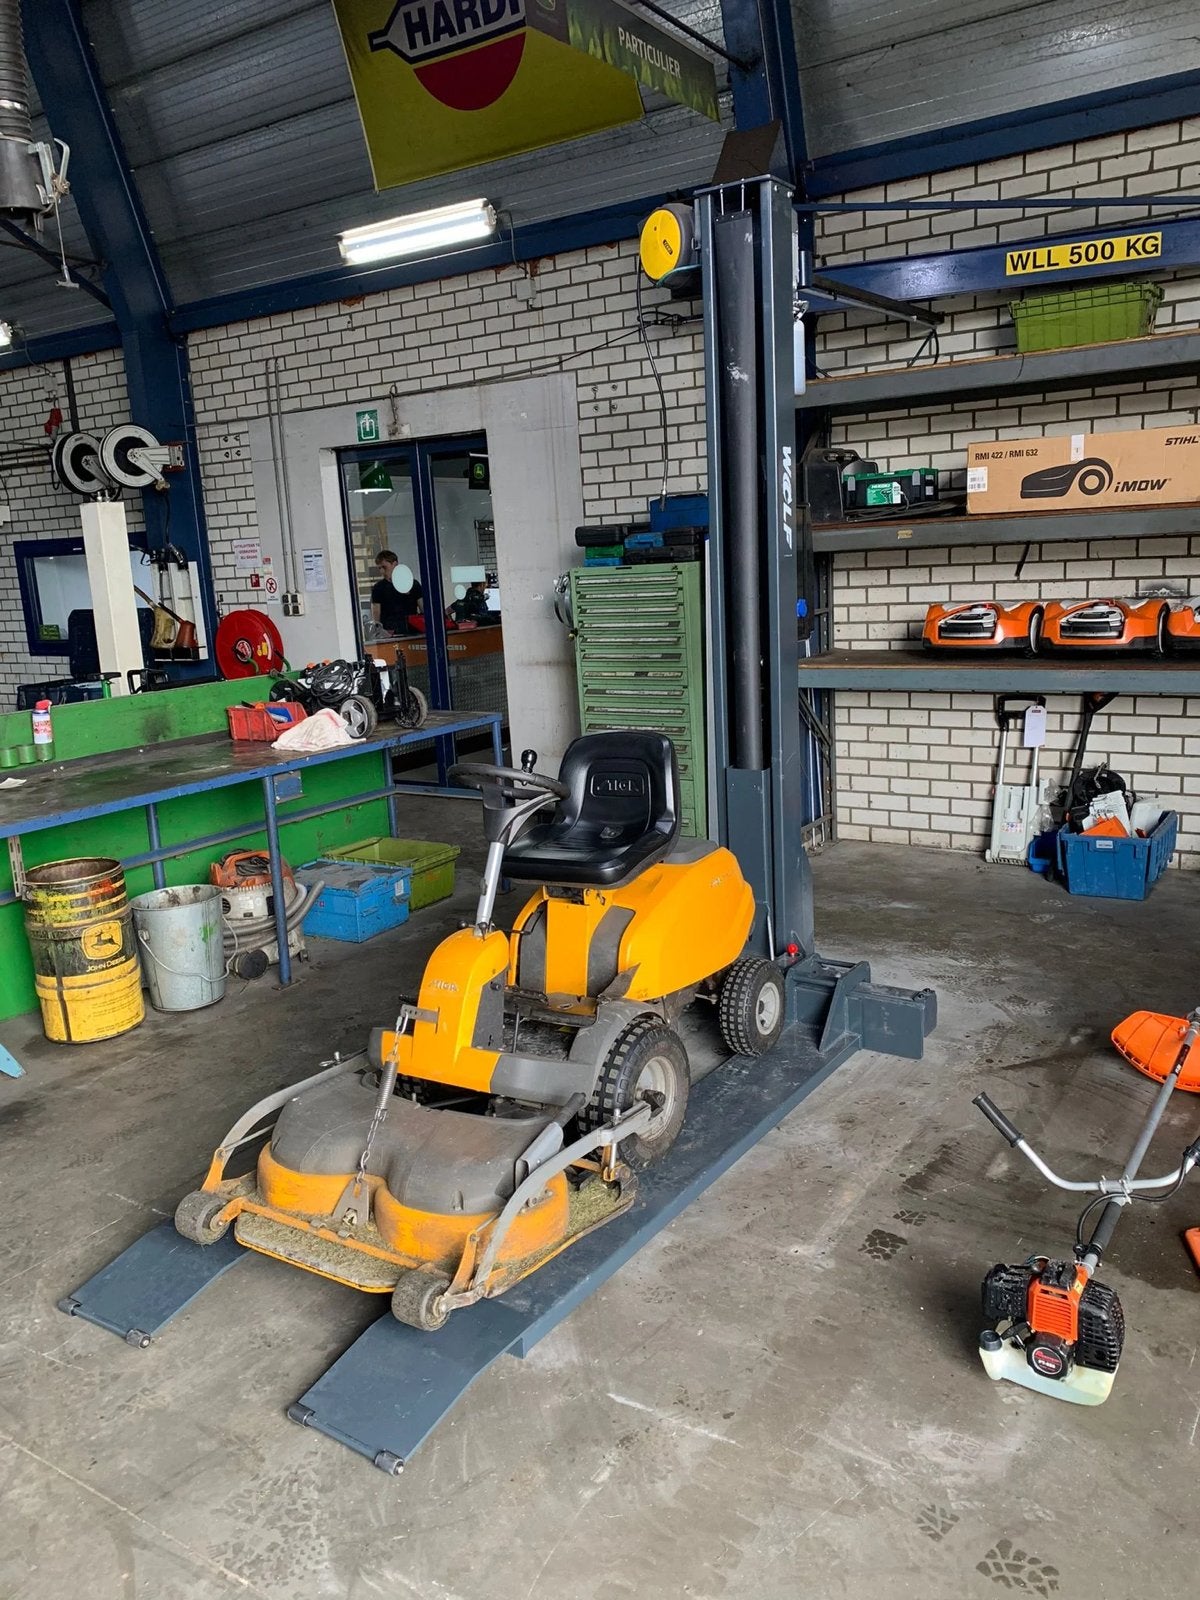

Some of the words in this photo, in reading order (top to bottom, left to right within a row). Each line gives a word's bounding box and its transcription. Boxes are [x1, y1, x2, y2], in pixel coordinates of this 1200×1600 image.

[618, 27, 681, 78] PARTICULIER
[1009, 249, 1059, 272] WLL
[1069, 241, 1115, 264] 500
[1126, 235, 1160, 257] KG
[1165, 436, 1199, 446] STIHL
[975, 452, 990, 460] RMI
[991, 451, 1003, 459] 422
[1009, 449, 1024, 458] RMI
[1025, 448, 1039, 457] 632
[1114, 479, 1168, 492] iMOW
